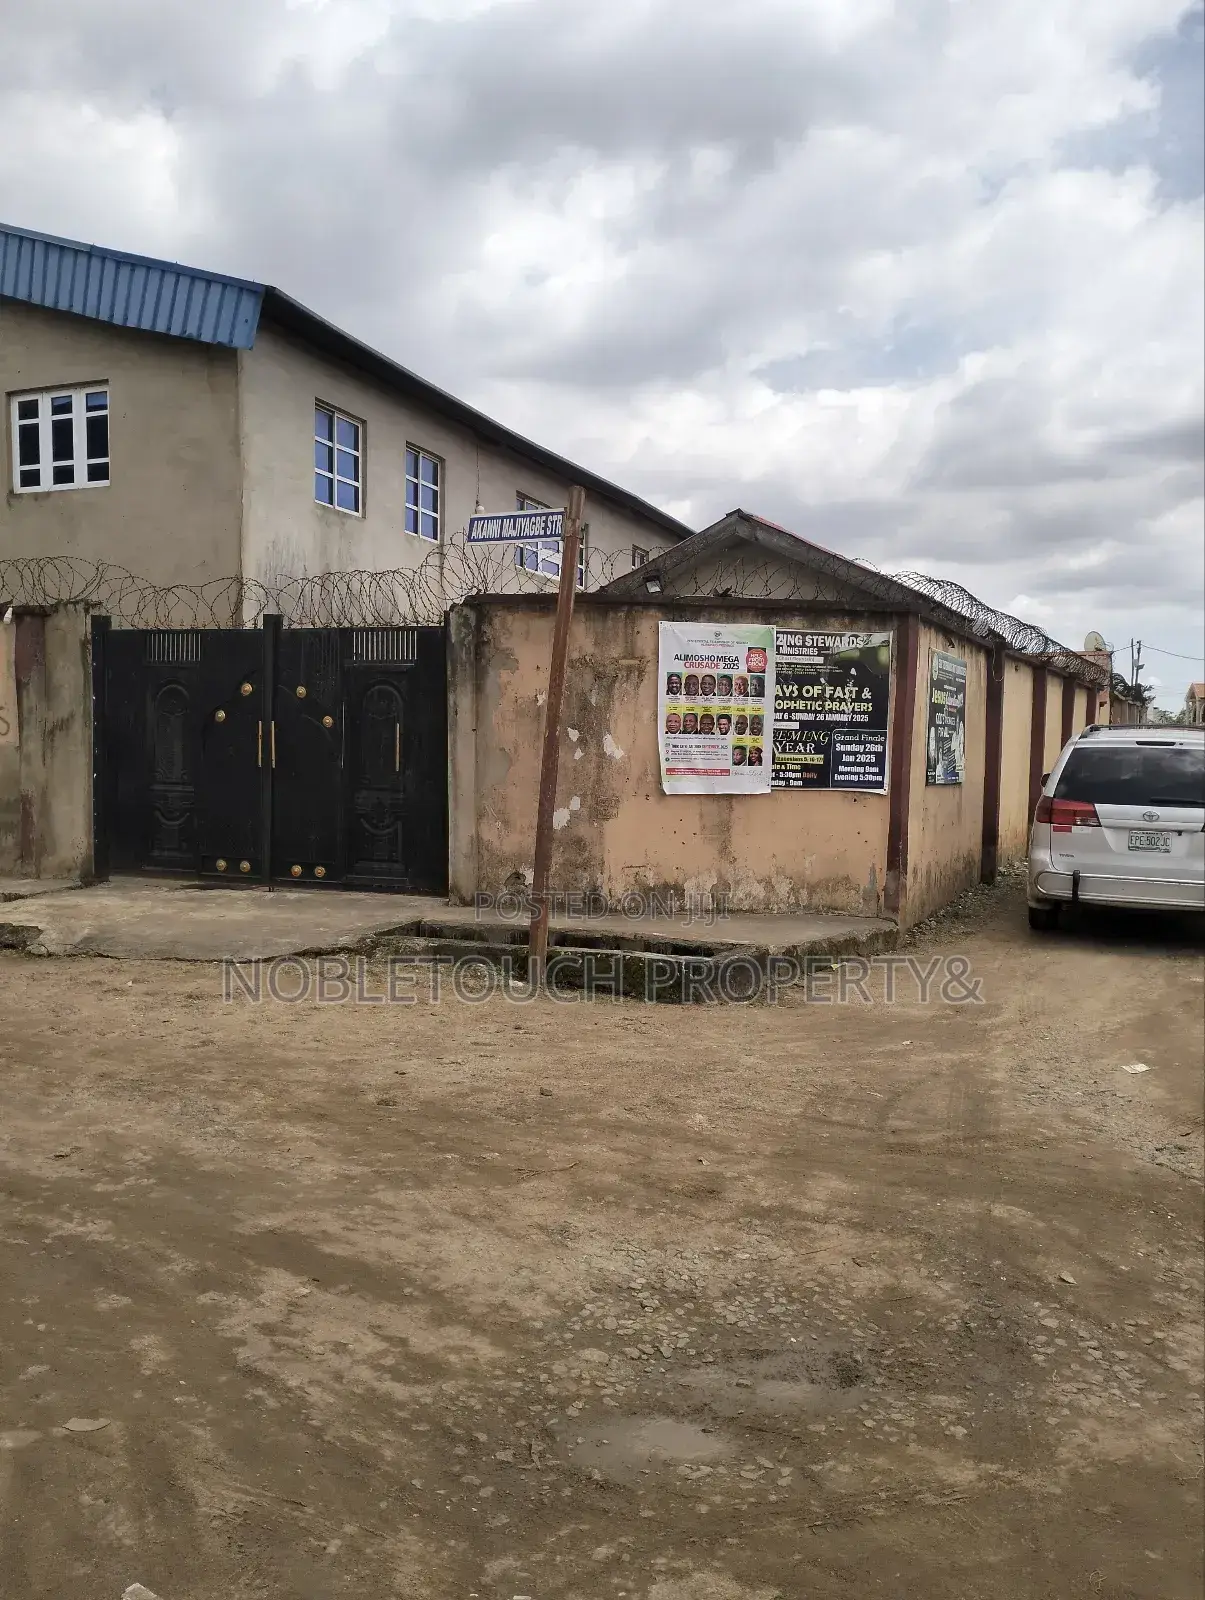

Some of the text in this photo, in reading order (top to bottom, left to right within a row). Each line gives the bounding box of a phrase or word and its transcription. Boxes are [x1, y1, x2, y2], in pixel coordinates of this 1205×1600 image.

[546, 515, 563, 534] STR
[776, 633, 803, 646] ZING
[779, 646, 818, 655] MINISTRIES
[674, 654, 716, 662] ALIMOSHO
[716, 655, 740, 663] MEGA
[684, 661, 740, 670] CRUSADE 2025
[775, 684, 872, 699] AYS OF FAST &
[775, 700, 823, 711] OPHETIC
[825, 701, 873, 712] PRAYERS
[852, 714, 869, 722] 2025
[834, 733, 885, 742] Grand Finale
[775, 740, 815, 753] YEAR
[835, 743, 864, 753] Sunday
[841, 753, 876, 762] Jan 2025
[838, 765, 864, 773] Morning
[834, 773, 859, 781] Evening
